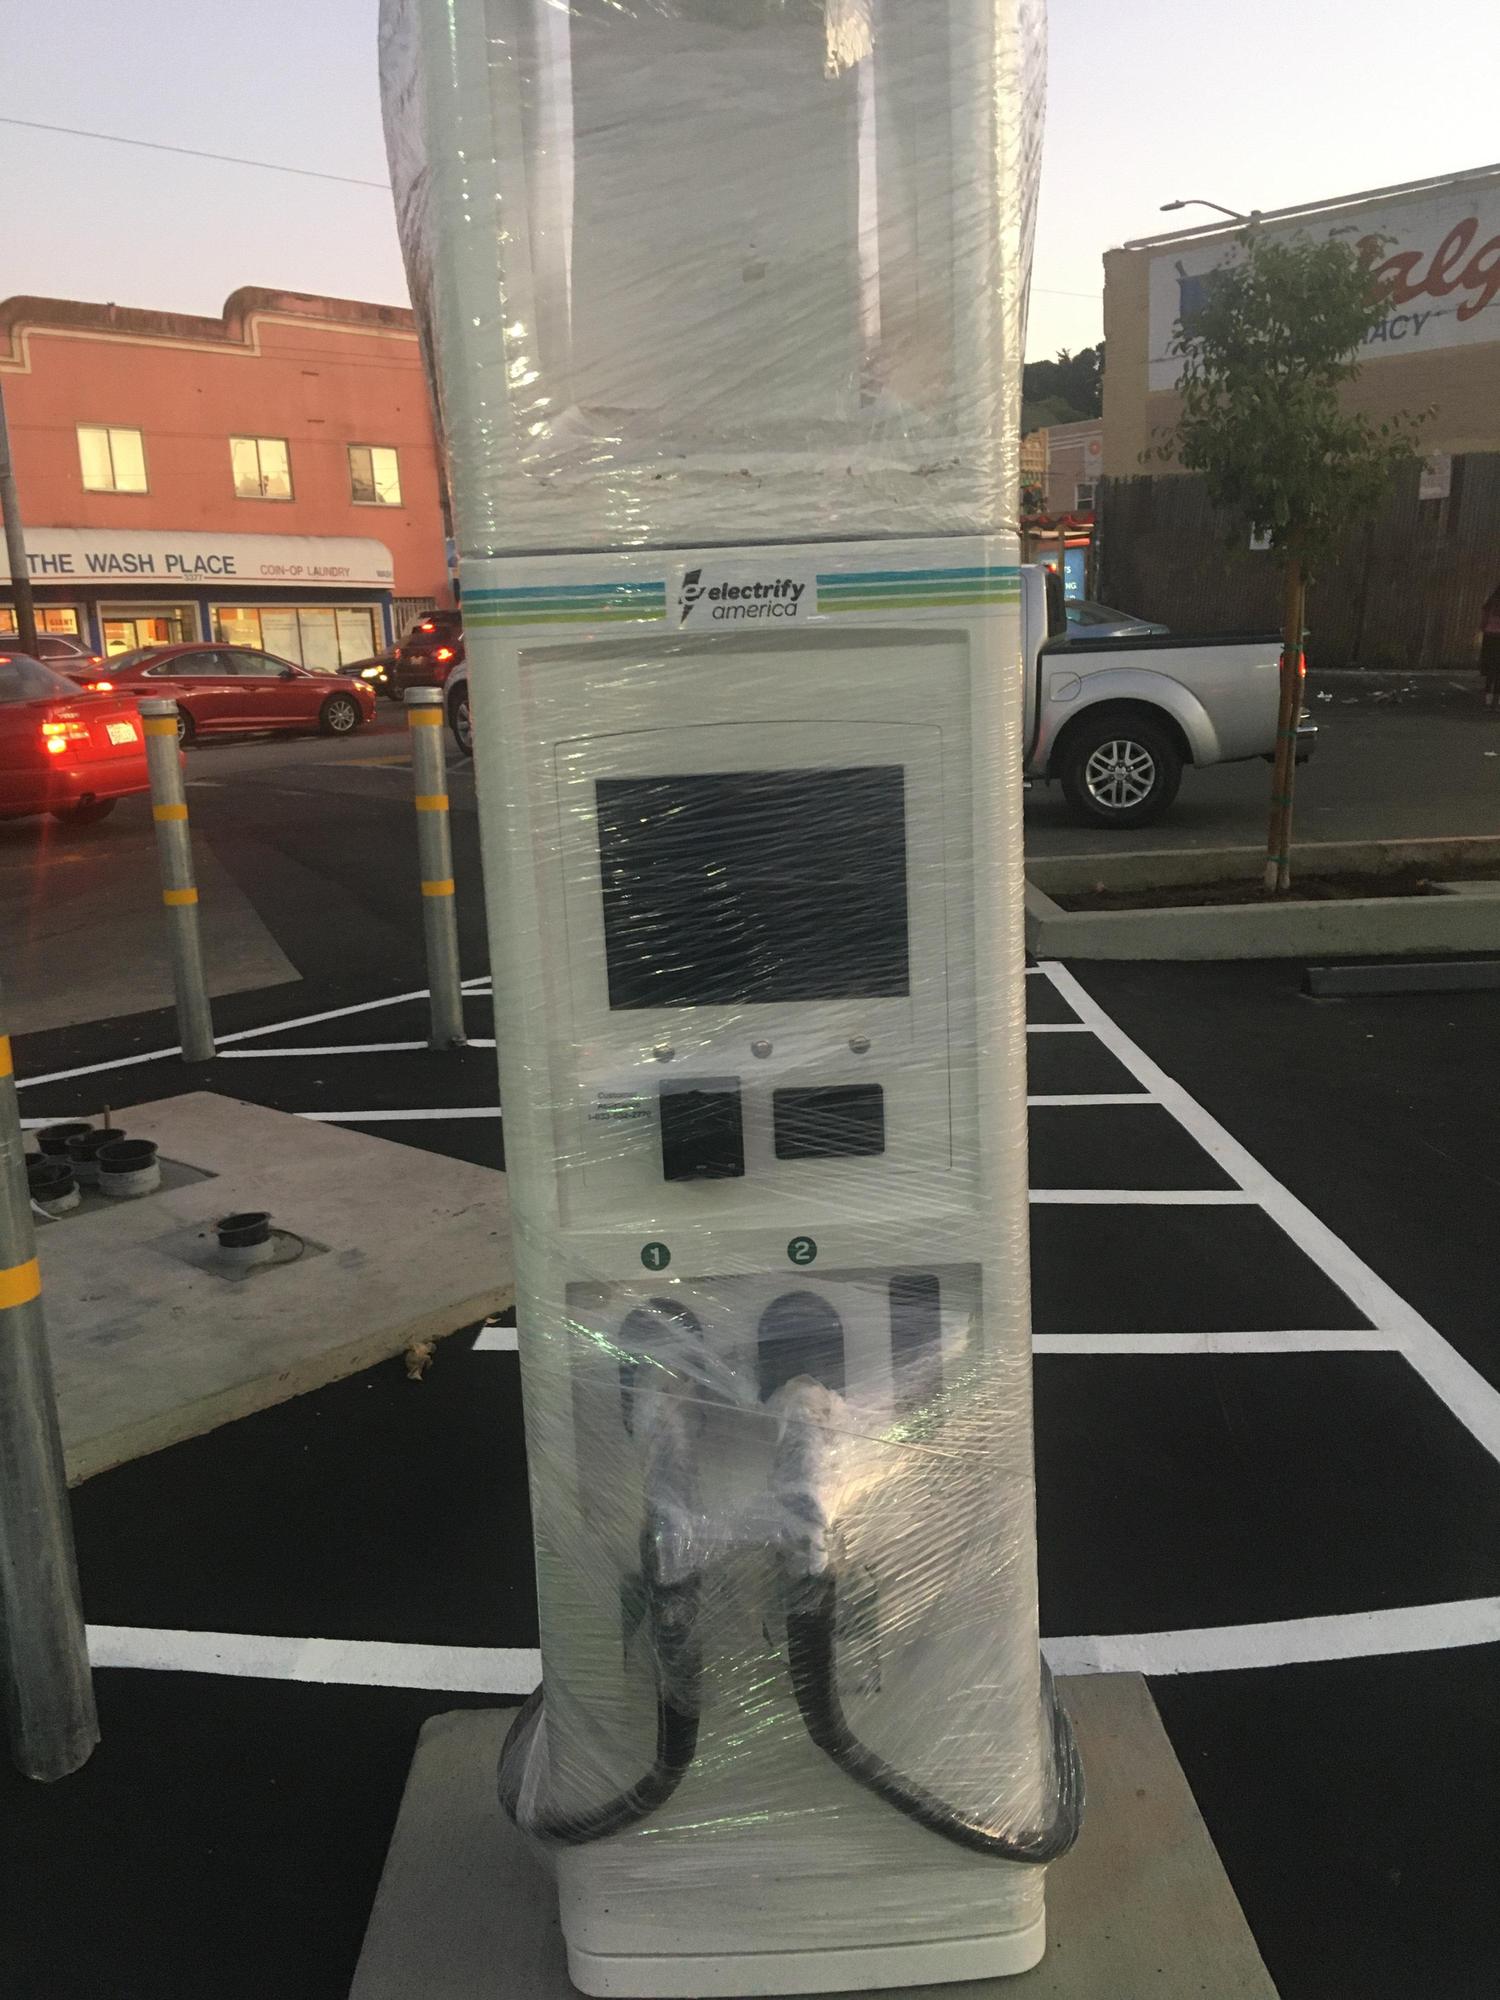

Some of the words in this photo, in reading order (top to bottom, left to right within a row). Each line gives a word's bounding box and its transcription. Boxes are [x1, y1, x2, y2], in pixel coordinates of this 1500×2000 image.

[27, 554, 74, 573] THE
[85, 553, 154, 573] WASH
[165, 554, 237, 574] PLACE
[260, 564, 303, 576] COIN-OP
[307, 566, 351, 577] LAUNDRY
[708, 579, 805, 601] electrify
[712, 601, 798, 619] america
[650, 1247, 660, 1266] 1
[795, 1241, 810, 1260] 2
